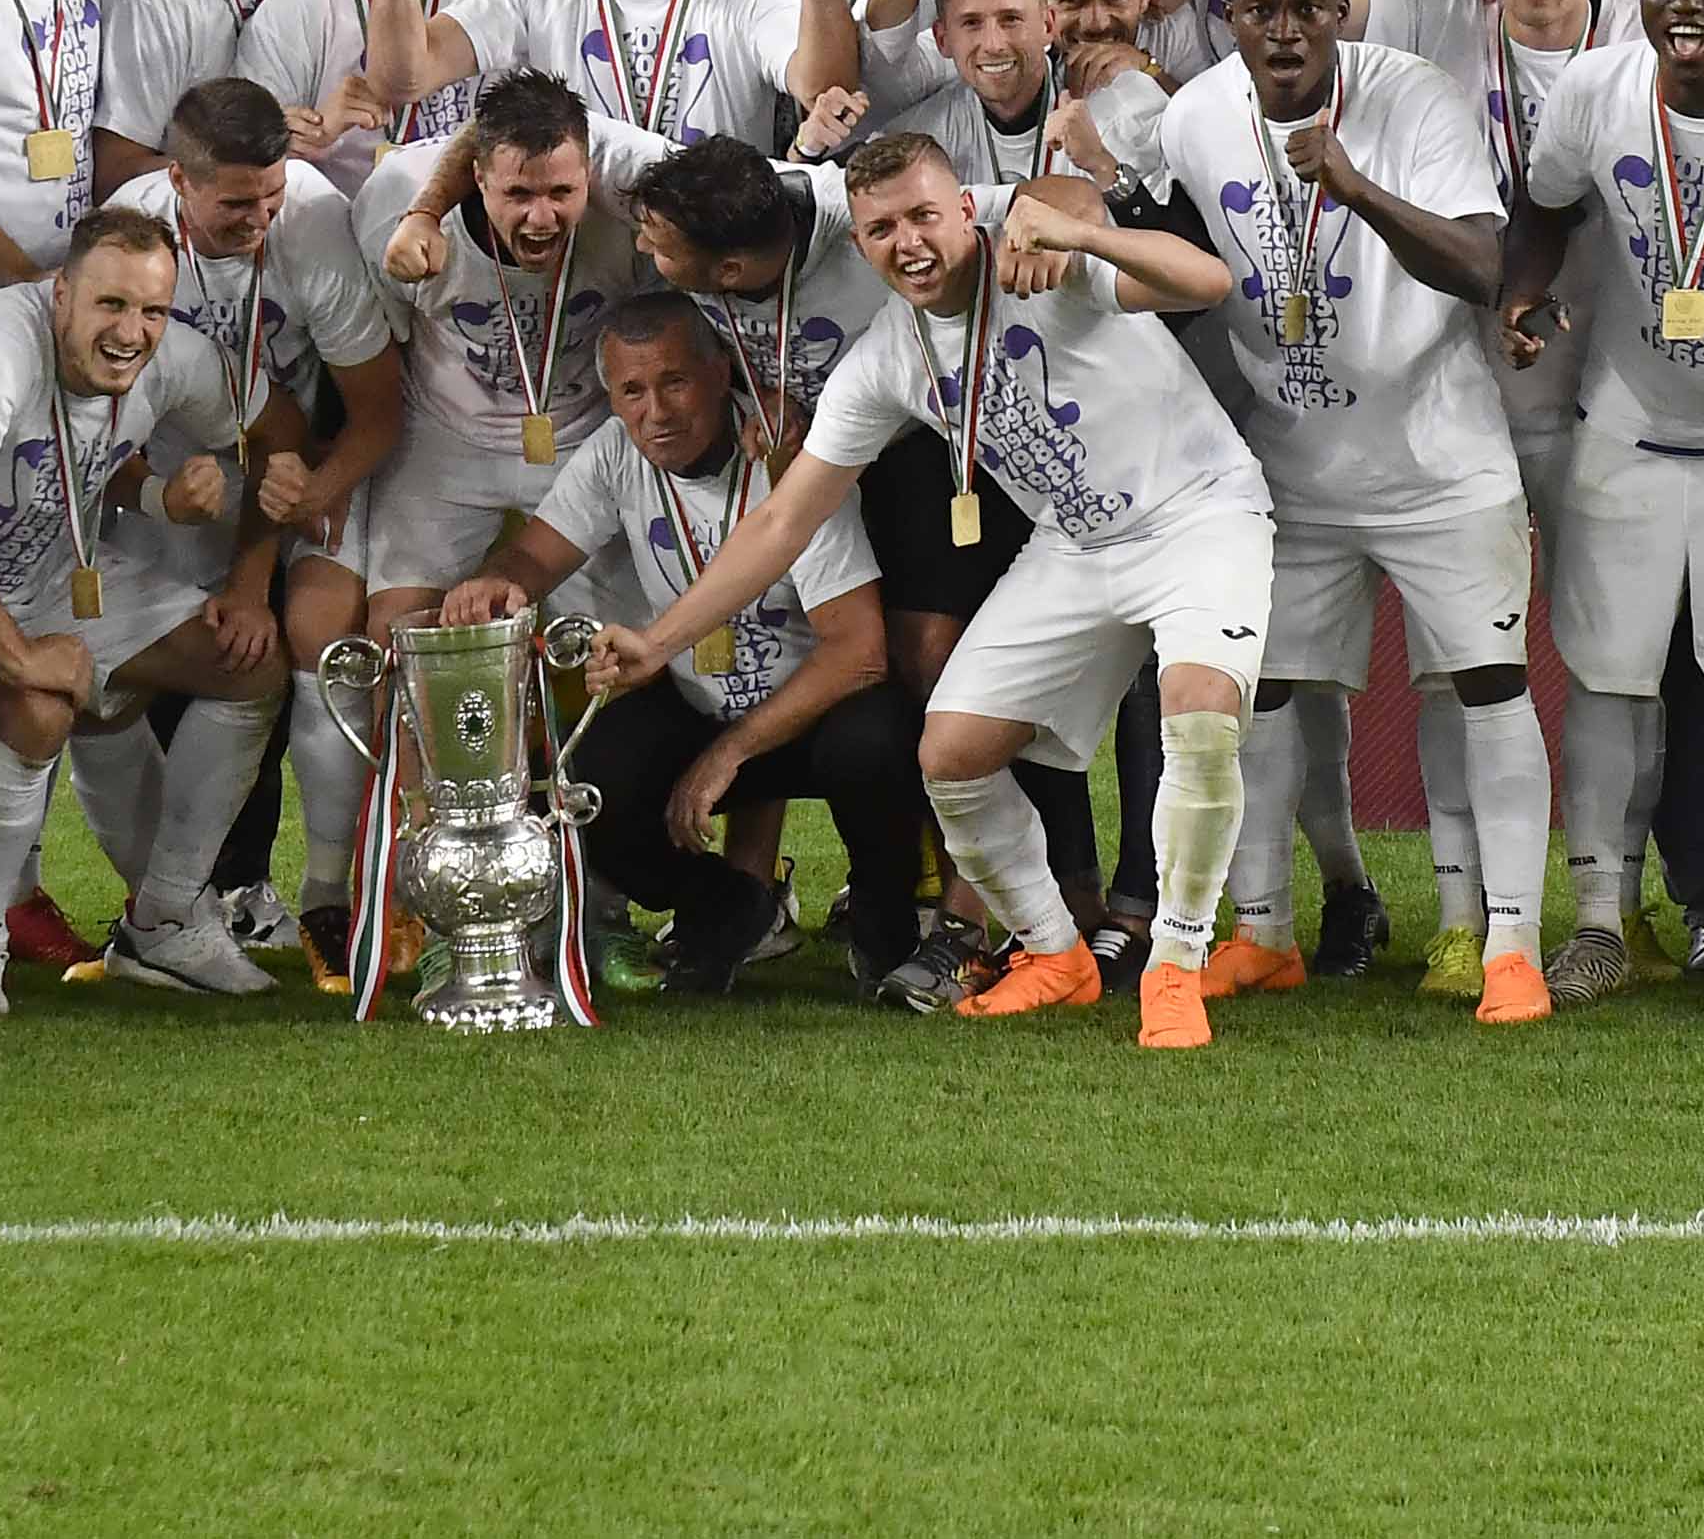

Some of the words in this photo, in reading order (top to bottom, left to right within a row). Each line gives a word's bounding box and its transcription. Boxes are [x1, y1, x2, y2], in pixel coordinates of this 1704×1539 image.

[1282, 346, 1327, 365] 1975
[1283, 365, 1325, 381] 1970
[1279, 379, 1345, 407] 1969
